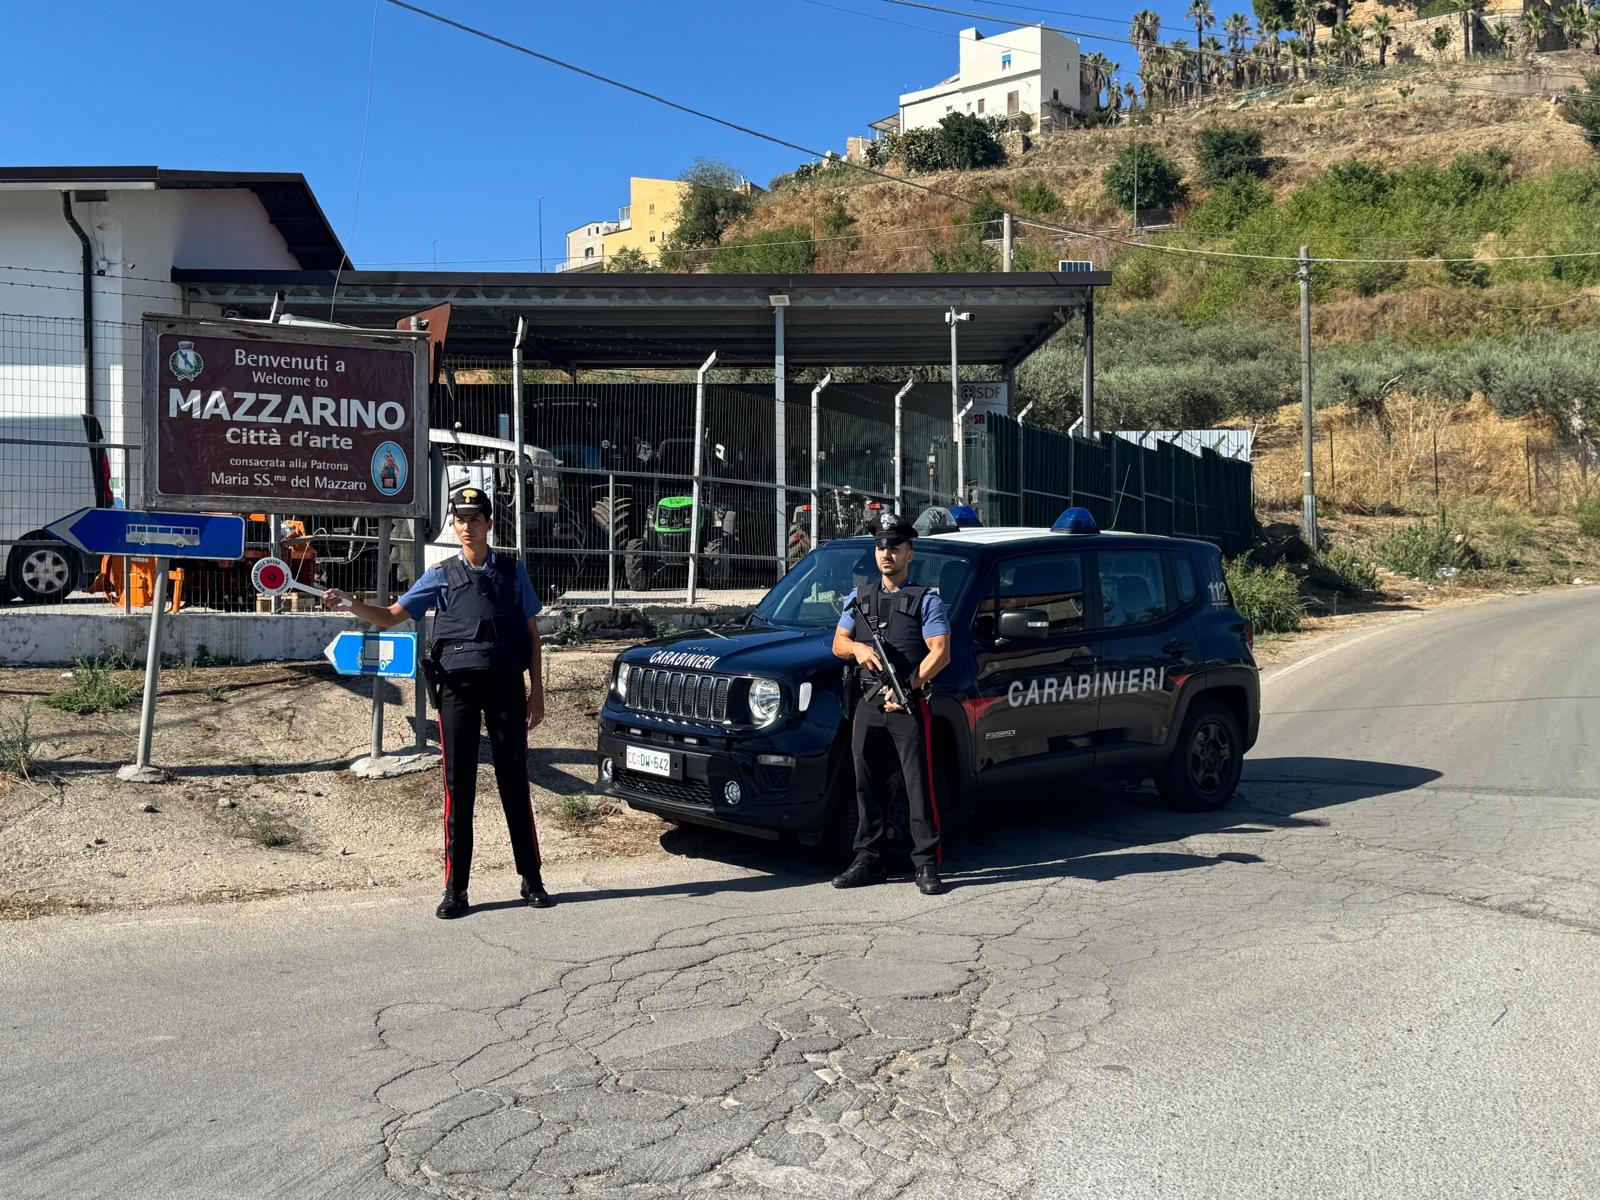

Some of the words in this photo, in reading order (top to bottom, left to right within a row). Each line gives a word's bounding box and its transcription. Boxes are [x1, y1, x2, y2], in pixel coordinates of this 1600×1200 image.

[234, 348, 329, 372] Benvenuti
[335, 359, 346, 373] a
[252, 371, 311, 387] Welcome
[315, 376, 329, 388] to
[976, 387, 1001, 399] SDF
[168, 388, 406, 431] MAZZARINO
[225, 427, 281, 446] Città
[289, 430, 353, 450] d'arte
[229, 457, 286, 468] consacrata
[289, 458, 308, 469] alla
[310, 459, 349, 471] Patrona
[211, 472, 249, 486] Maria
[290, 475, 310, 488] del
[314, 477, 367, 491] Mazzaro
[1208, 582, 1228, 601] 112
[649, 650, 720, 670] CARABINIERI
[1008, 667, 1165, 708] CARABINIERI
